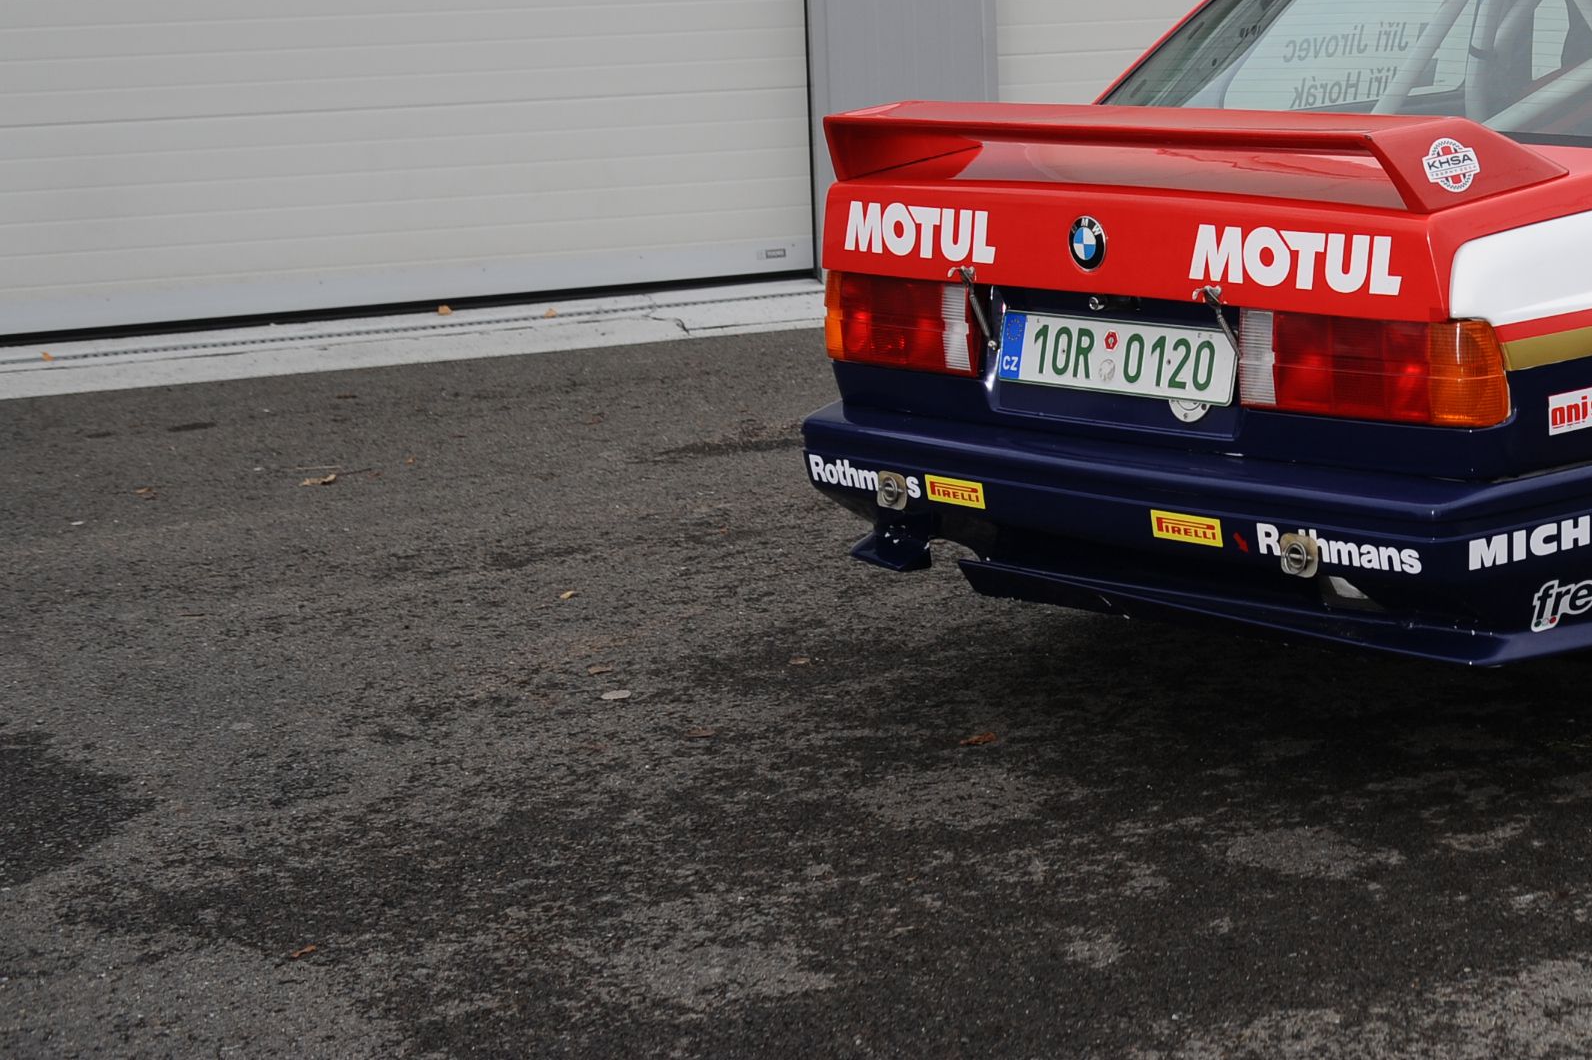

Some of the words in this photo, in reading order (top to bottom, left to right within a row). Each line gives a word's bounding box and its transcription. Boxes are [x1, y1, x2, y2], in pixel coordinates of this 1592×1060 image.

[1427, 154, 1473, 170] KHSA
[844, 200, 996, 264] MOTUL
[1188, 224, 1402, 296] MOTUL
[1002, 355, 1019, 371] CZ
[1034, 324, 1095, 380] 10R
[1123, 333, 1216, 391] 0120
[808, 453, 922, 499] Rothms
[929, 481, 980, 503] PIRELLI
[1155, 516, 1217, 541] PIRELLI
[1256, 522, 1422, 575] Rhmans
